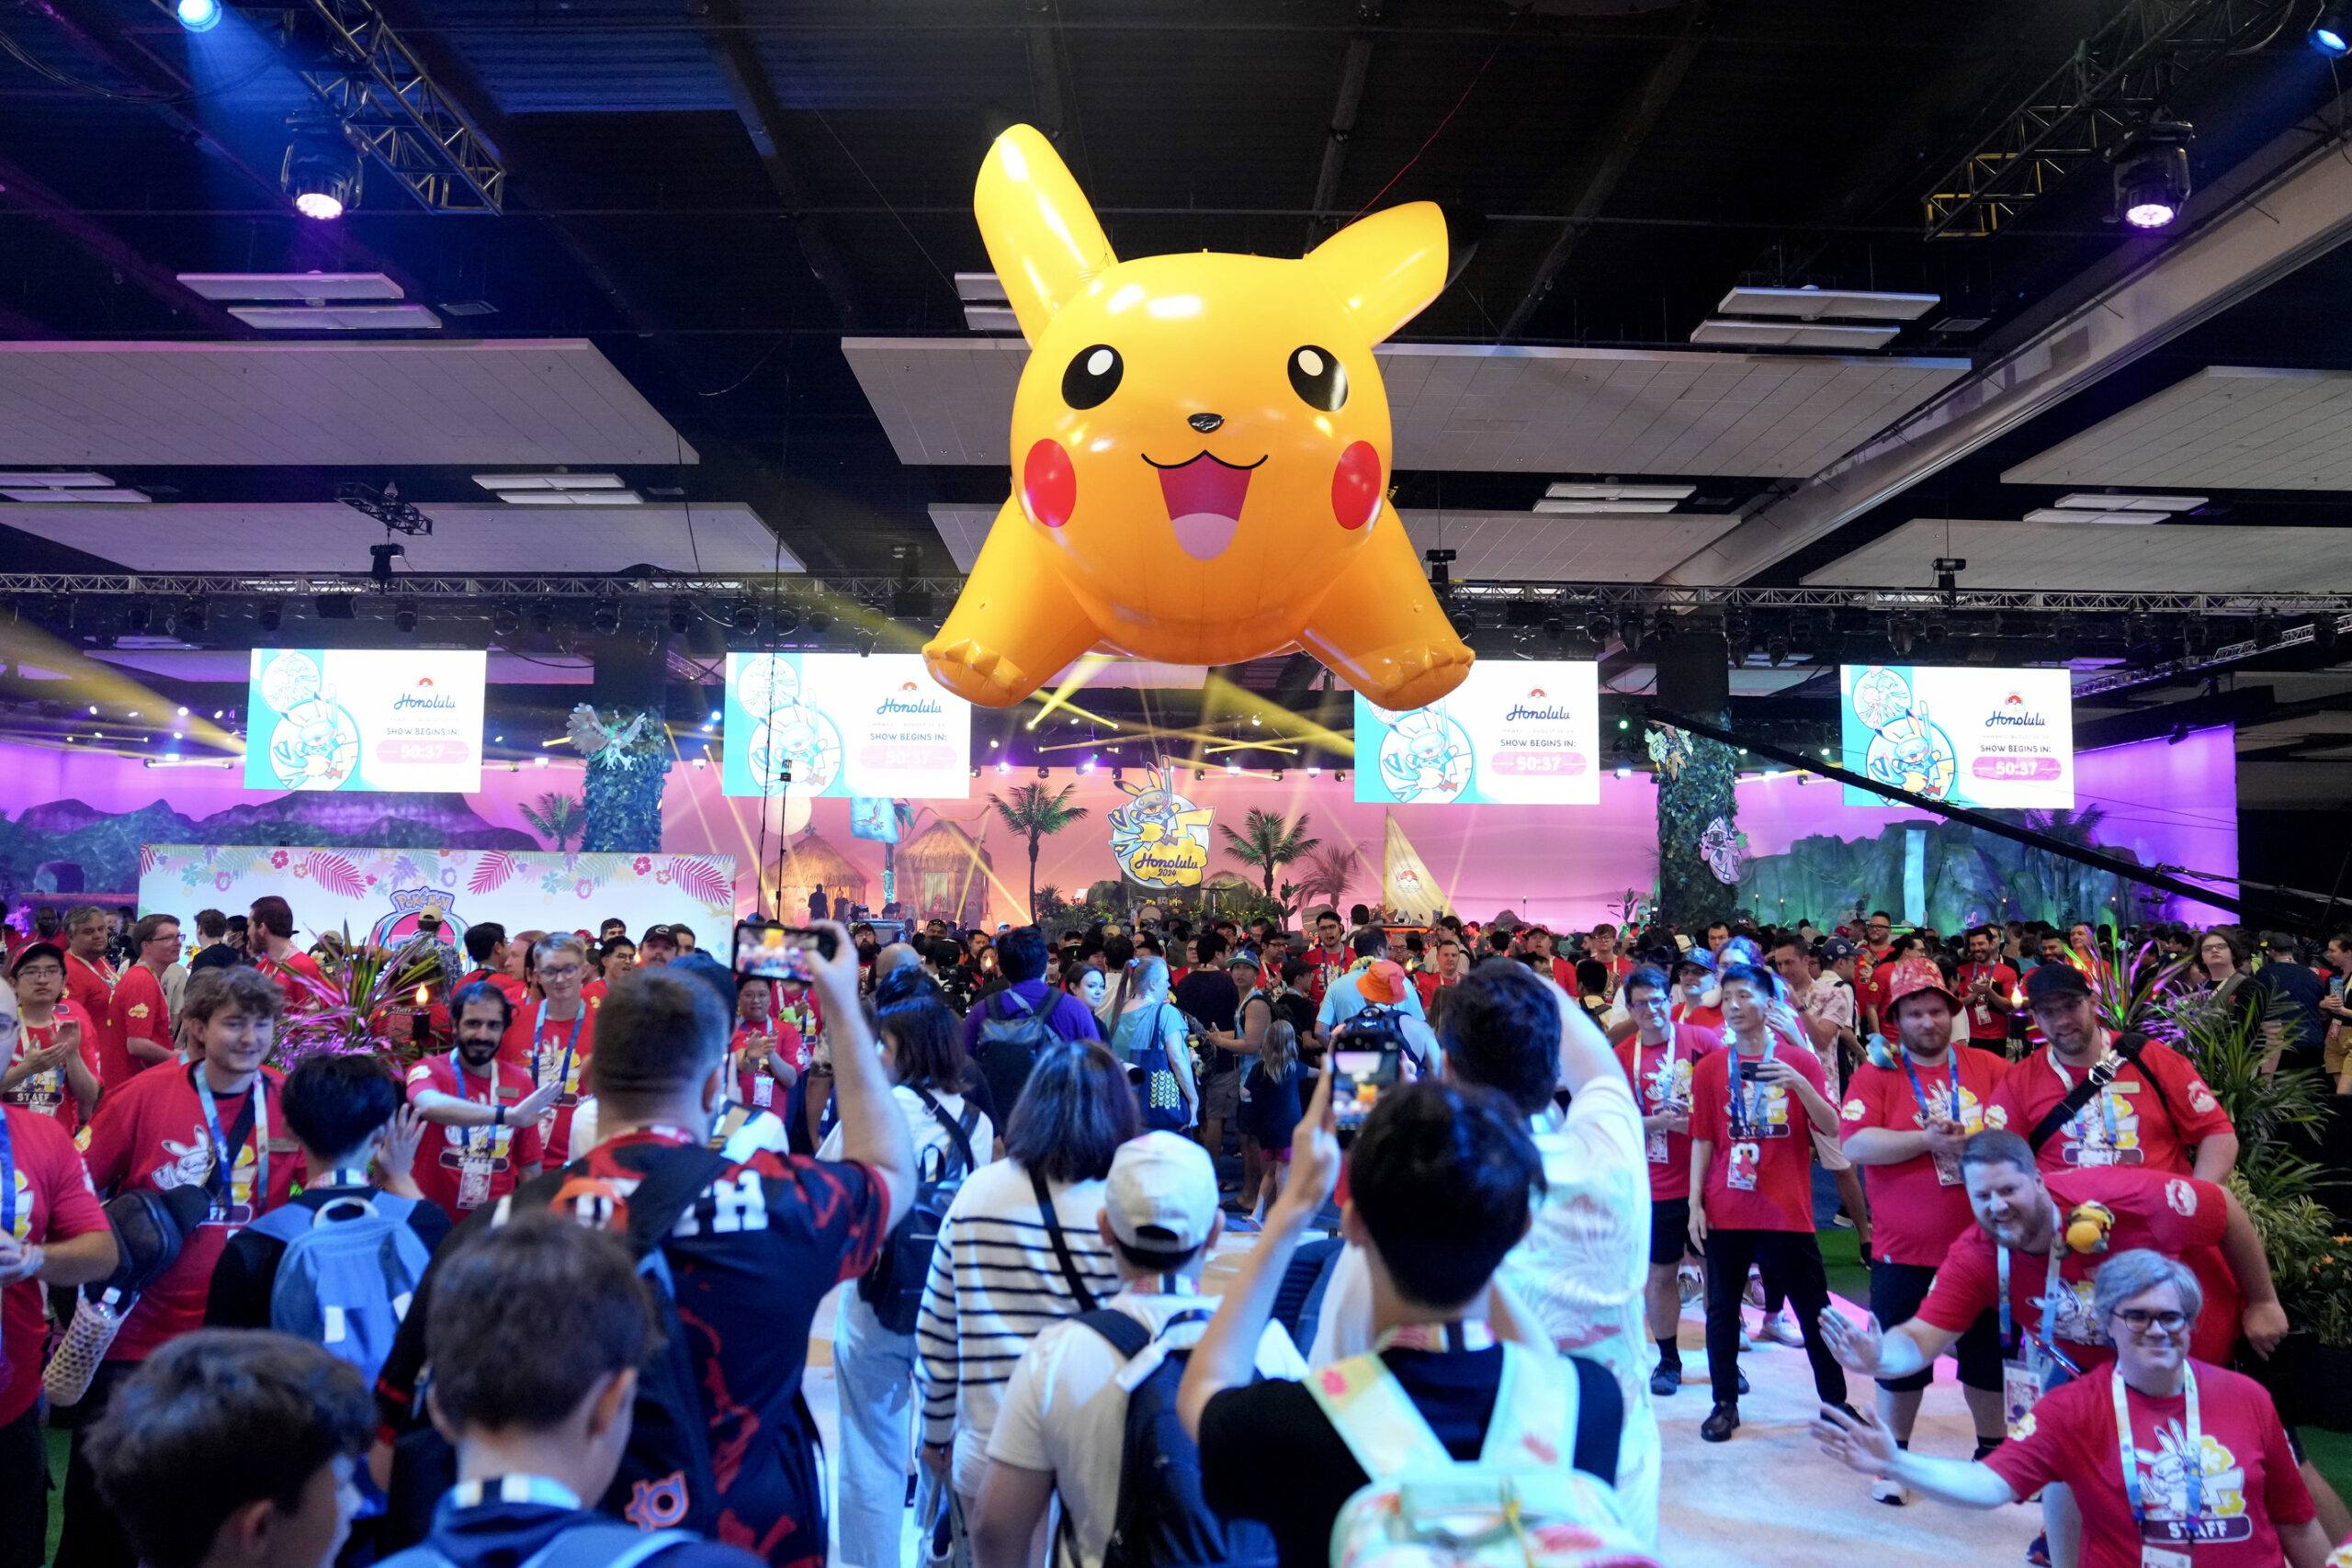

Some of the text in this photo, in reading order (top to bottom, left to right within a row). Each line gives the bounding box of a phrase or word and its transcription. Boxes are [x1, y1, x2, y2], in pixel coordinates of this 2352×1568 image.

[394, 693, 456, 710] Honolulu
[876, 698, 942, 715] Honolulu
[1506, 704, 1570, 721] Honolulu
[1985, 710, 2045, 727] Honolulu
[400, 744, 446, 760] 50:37
[1516, 756, 1562, 773] 50:37
[1995, 761, 2038, 776] 50:37
[1135, 852, 1198, 870] Honolulu
[1158, 868, 1177, 877] 2024
[17, 1092, 50, 1102] STAFF
